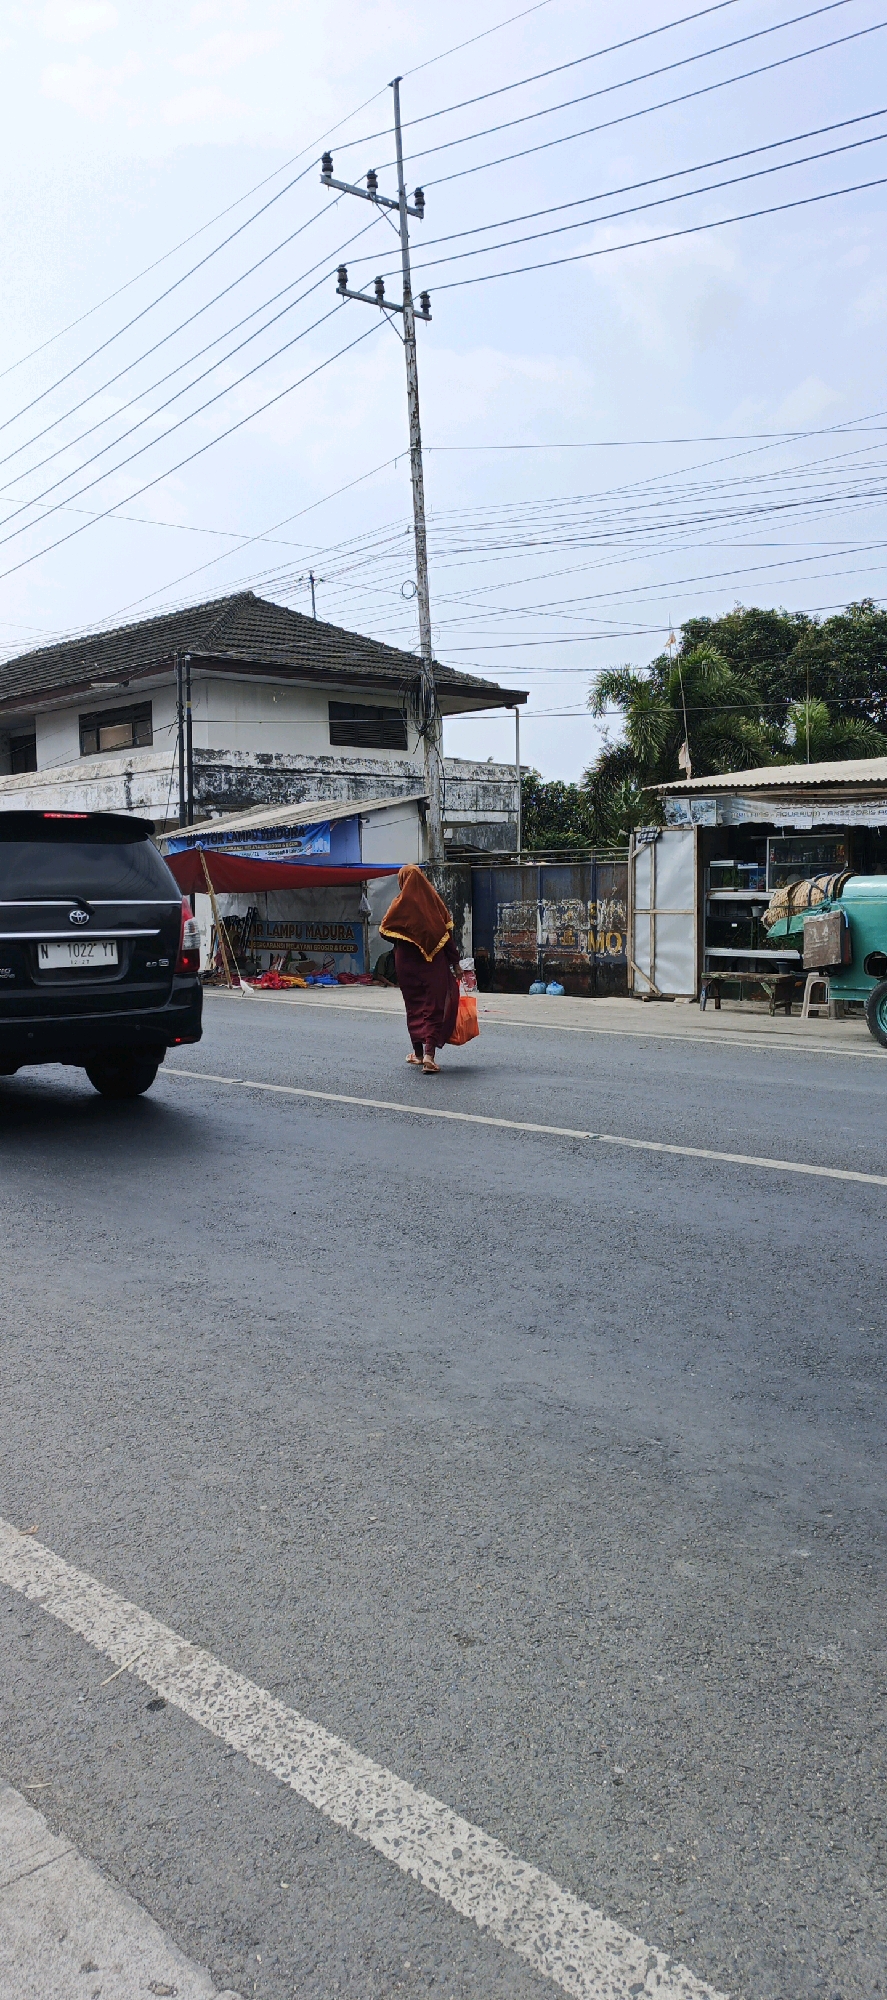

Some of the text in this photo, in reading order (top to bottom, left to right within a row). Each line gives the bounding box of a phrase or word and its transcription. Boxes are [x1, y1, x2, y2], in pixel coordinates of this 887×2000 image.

[225, 828, 259, 844] LAMPU
[261, 824, 306, 841] MADURA
[266, 923, 303, 939] LAMPU
[305, 924, 355, 941] MADURA
[41, 942, 115, 959] N 1022 YT
[588, 930, 627, 956] MO
